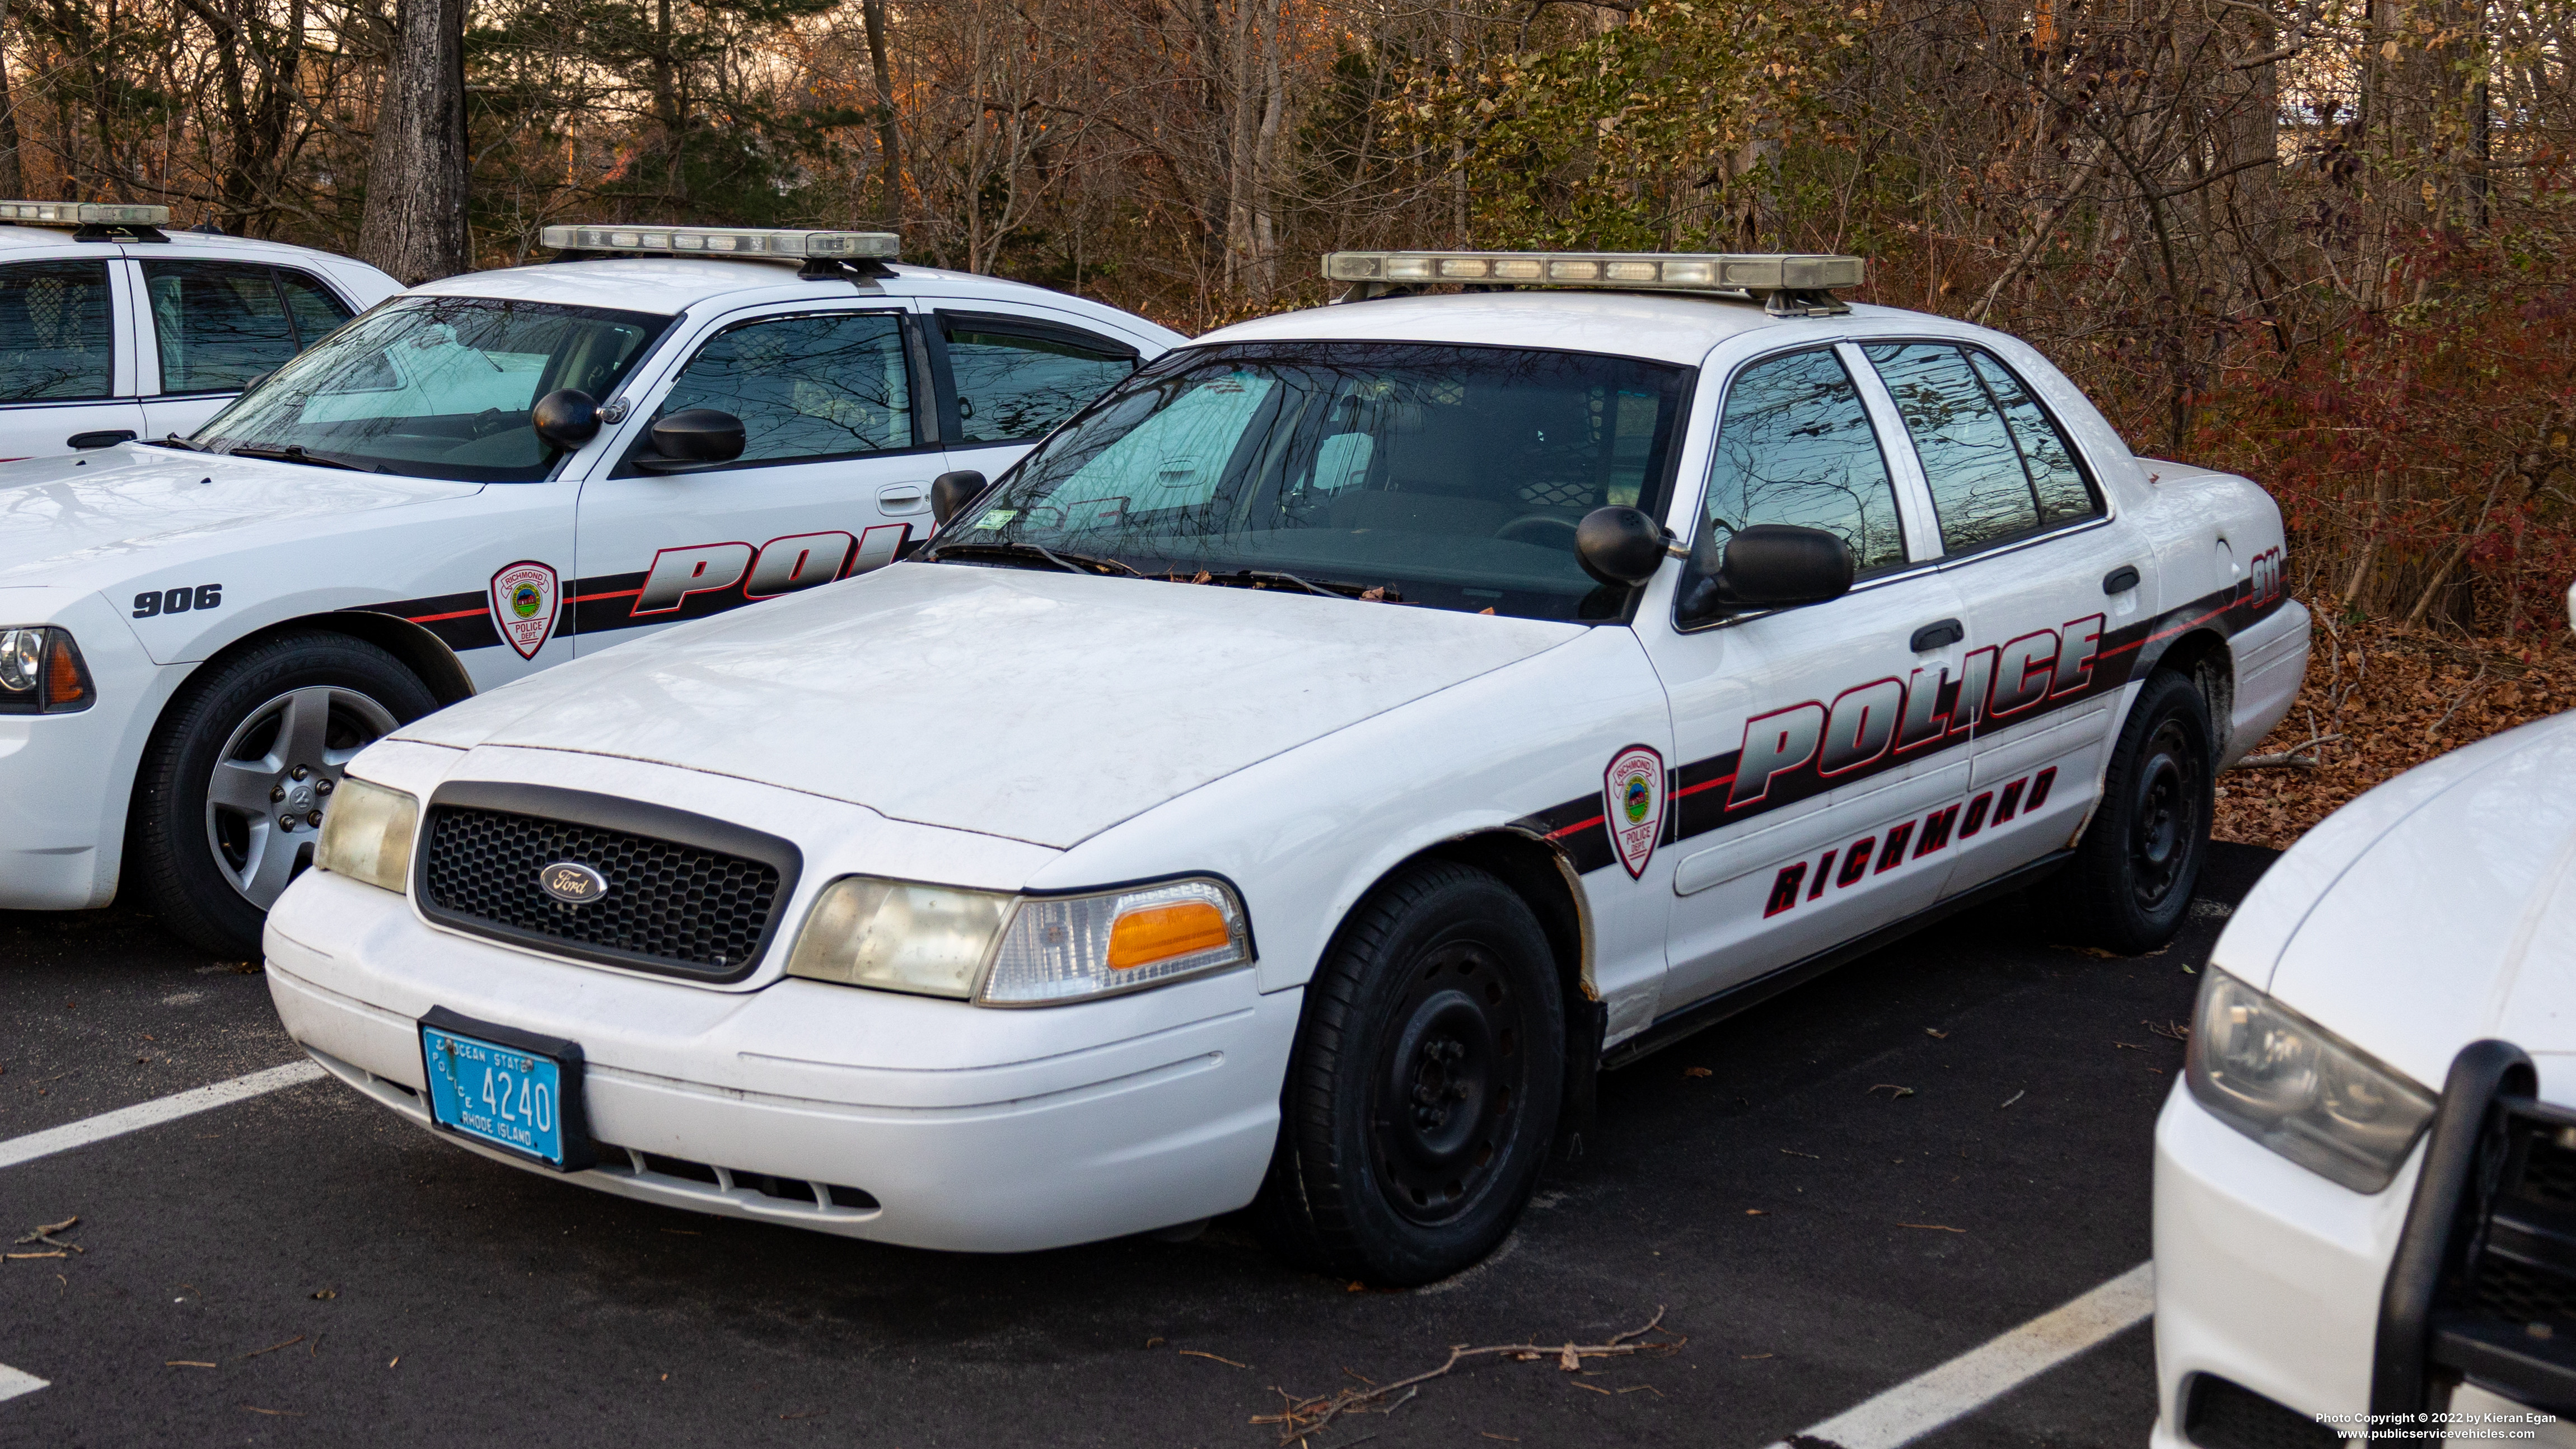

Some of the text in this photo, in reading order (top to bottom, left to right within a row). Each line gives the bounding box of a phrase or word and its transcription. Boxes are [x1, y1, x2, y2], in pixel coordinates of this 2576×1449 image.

[505, 571, 543, 585] RICHMOND
[2251, 544, 2280, 609] 911
[132, 583, 222, 619] 906
[516, 621, 543, 633] POLICE
[521, 632, 537, 640] DEPT.
[1724, 612, 2106, 812] POLICE
[1616, 759, 1651, 779] RICHMOND
[1626, 826, 1651, 845] POLICE
[1762, 765, 2058, 919] RICHMOND
[553, 869, 588, 895] Ford
[454, 1044, 530, 1073] OCEAN STATE
[432, 1052, 473, 1109] POLICE
[482, 1067, 551, 1133] 4240
[462, 1111, 532, 1147] RHODE ISLAND
